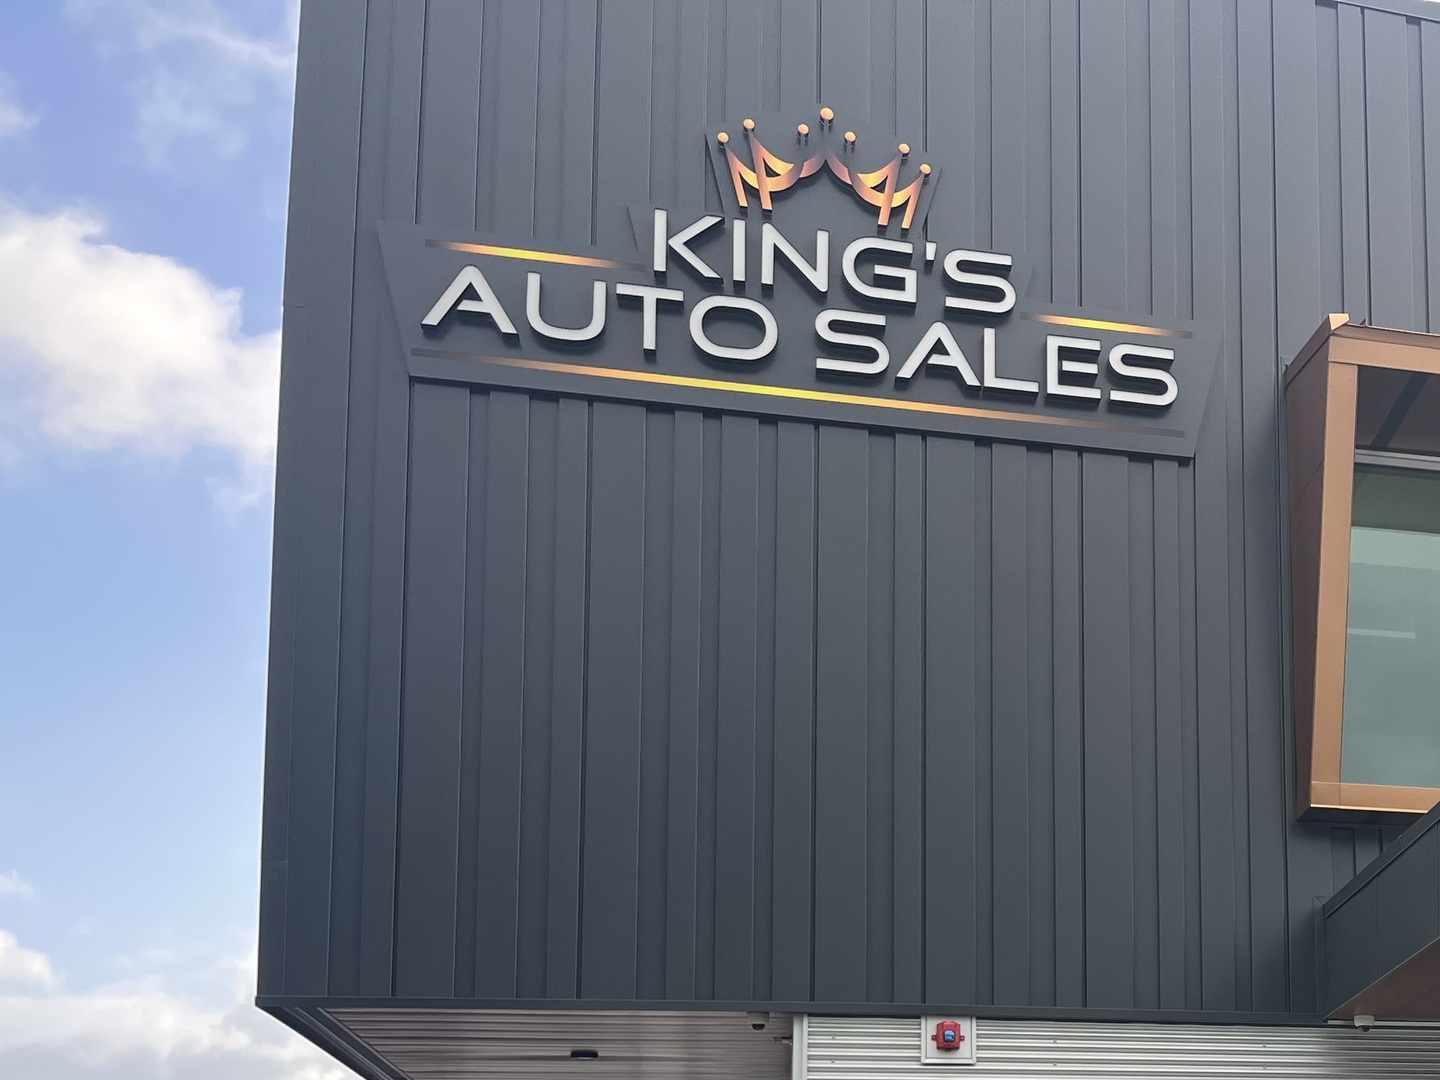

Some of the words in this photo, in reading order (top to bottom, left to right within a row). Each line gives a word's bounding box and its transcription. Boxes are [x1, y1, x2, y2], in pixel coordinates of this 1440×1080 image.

[653, 208, 1016, 315] KING'S
[421, 264, 778, 361] AUTO
[815, 309, 1178, 406] SALES
